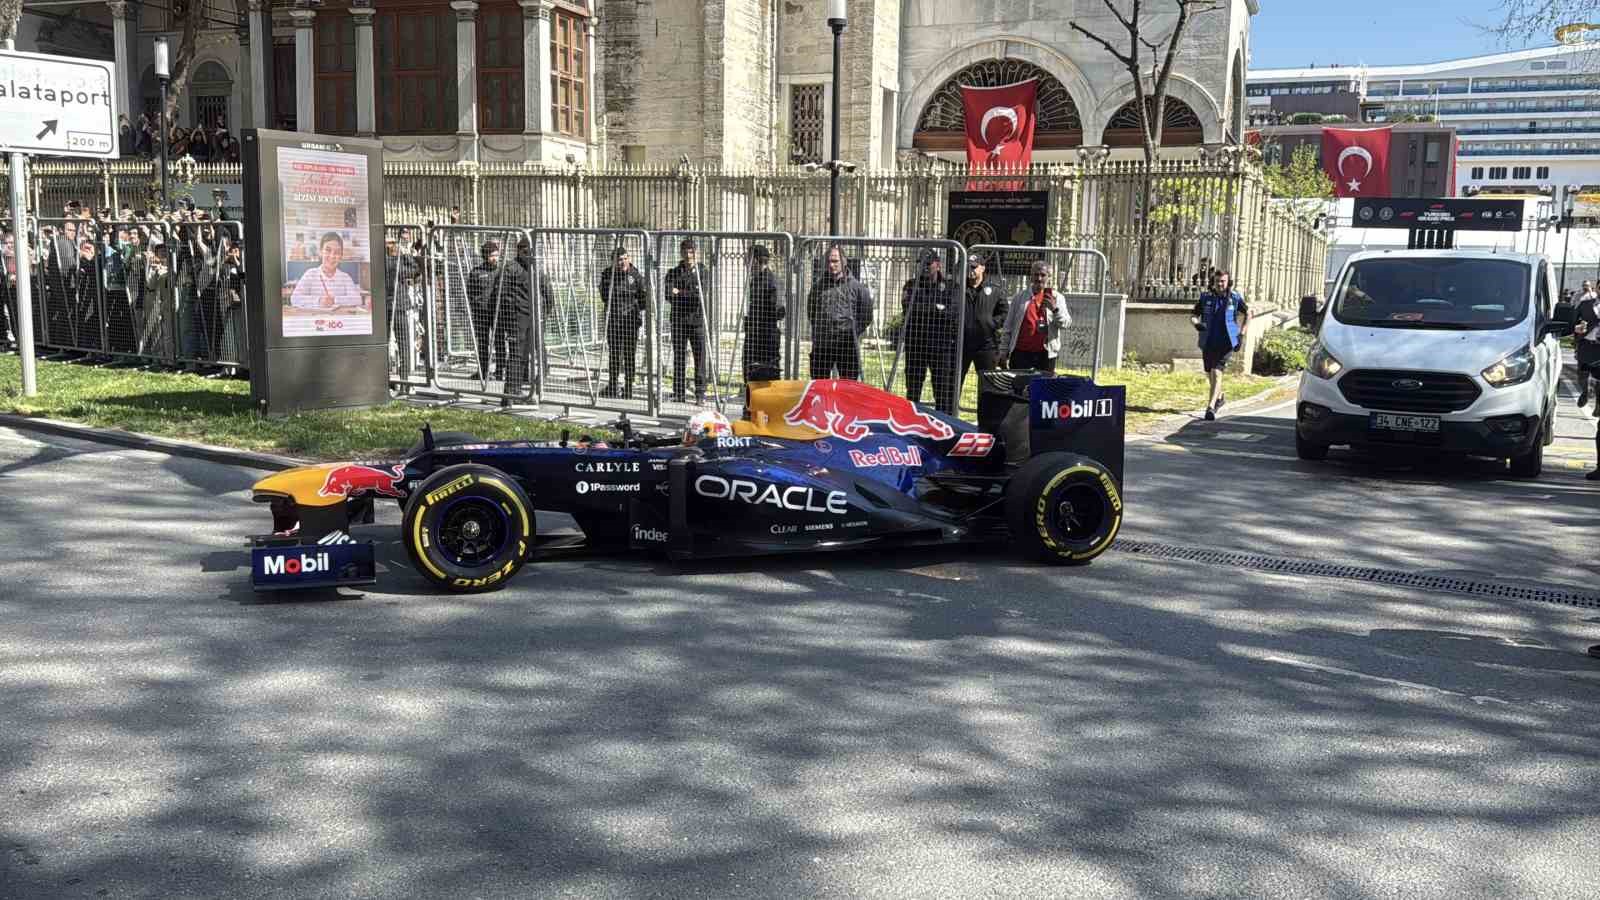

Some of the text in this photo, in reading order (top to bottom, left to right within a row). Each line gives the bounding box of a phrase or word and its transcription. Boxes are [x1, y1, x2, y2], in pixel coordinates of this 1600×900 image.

[72, 137, 95, 146] 200
[1041, 399, 1093, 419] Mobil
[717, 436, 752, 448] ROKT
[575, 462, 640, 473] CARLYLE
[425, 473, 475, 505] PIRELLI
[590, 482, 640, 492] 1Password
[694, 474, 848, 515] ORACLE
[263, 552, 329, 575] Mobil
